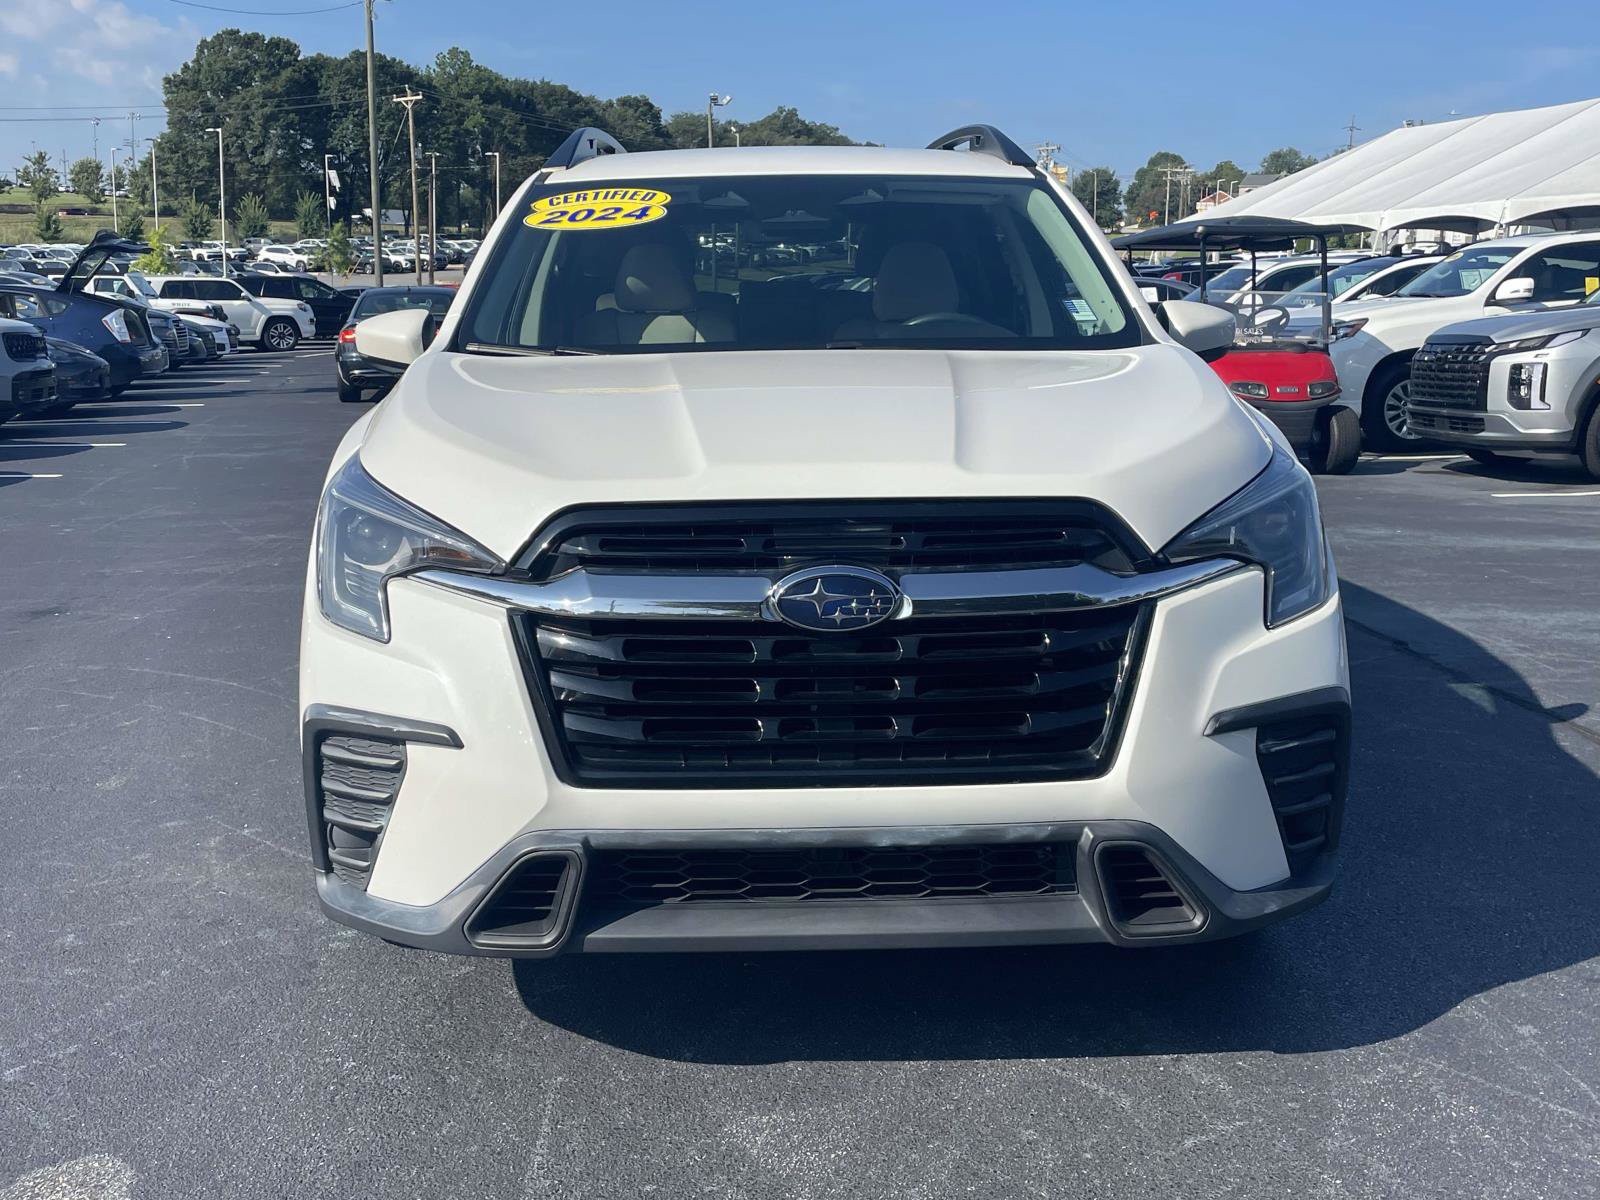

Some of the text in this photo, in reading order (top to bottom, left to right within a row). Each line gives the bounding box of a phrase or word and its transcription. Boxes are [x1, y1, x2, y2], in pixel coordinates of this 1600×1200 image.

[548, 190, 657, 206] CERTIFIED
[538, 205, 652, 225] 2024
[1243, 327, 1264, 335] SALES
